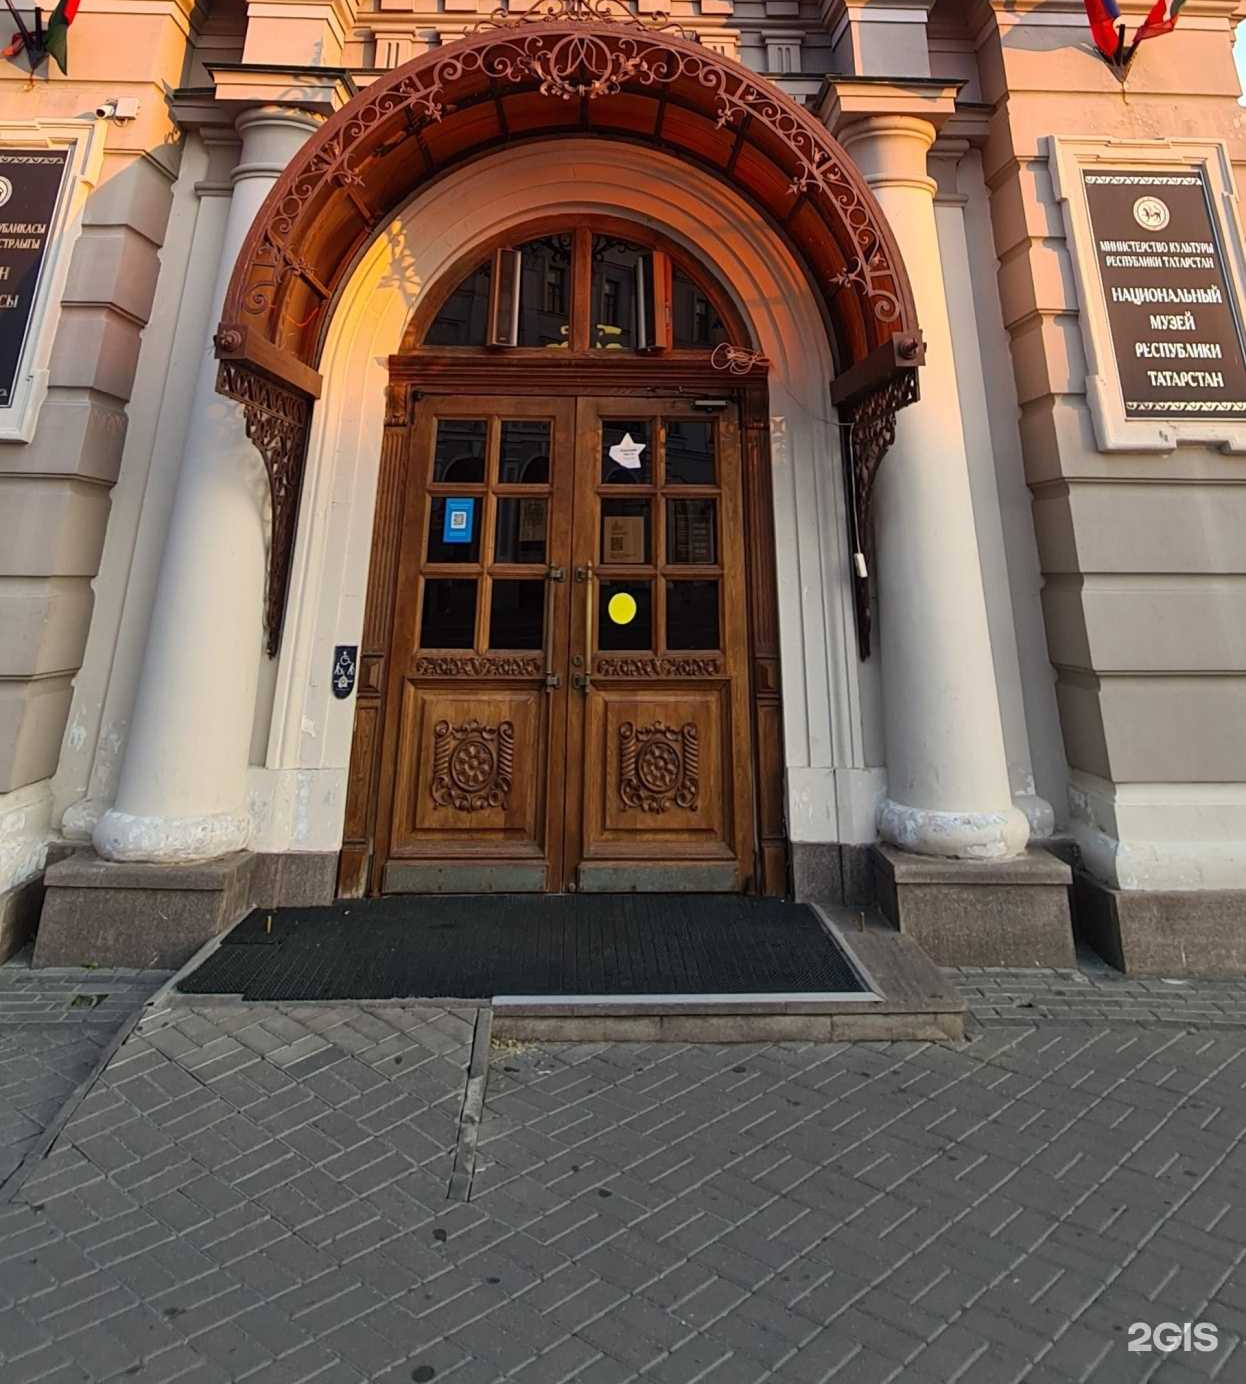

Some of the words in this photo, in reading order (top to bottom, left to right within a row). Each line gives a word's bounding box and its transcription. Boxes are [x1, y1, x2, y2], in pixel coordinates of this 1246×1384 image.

[1099, 240, 1168, 253] МИНИСТЕРСТВО
[1169, 241, 1214, 254] КУЛЬТУРЫ
[1105, 255, 1162, 267] РЕСПУБЛИКИ
[1163, 256, 1214, 269] ТАТАРСТАН
[1111, 284, 1222, 305] НАЦИОНАЛЬНЫЙ
[1149, 310, 1196, 330] МУЗЕЙ
[1135, 342, 1222, 359] РЕСПУБЛИКИ
[1147, 370, 1225, 387] ТАТАРСТАН
